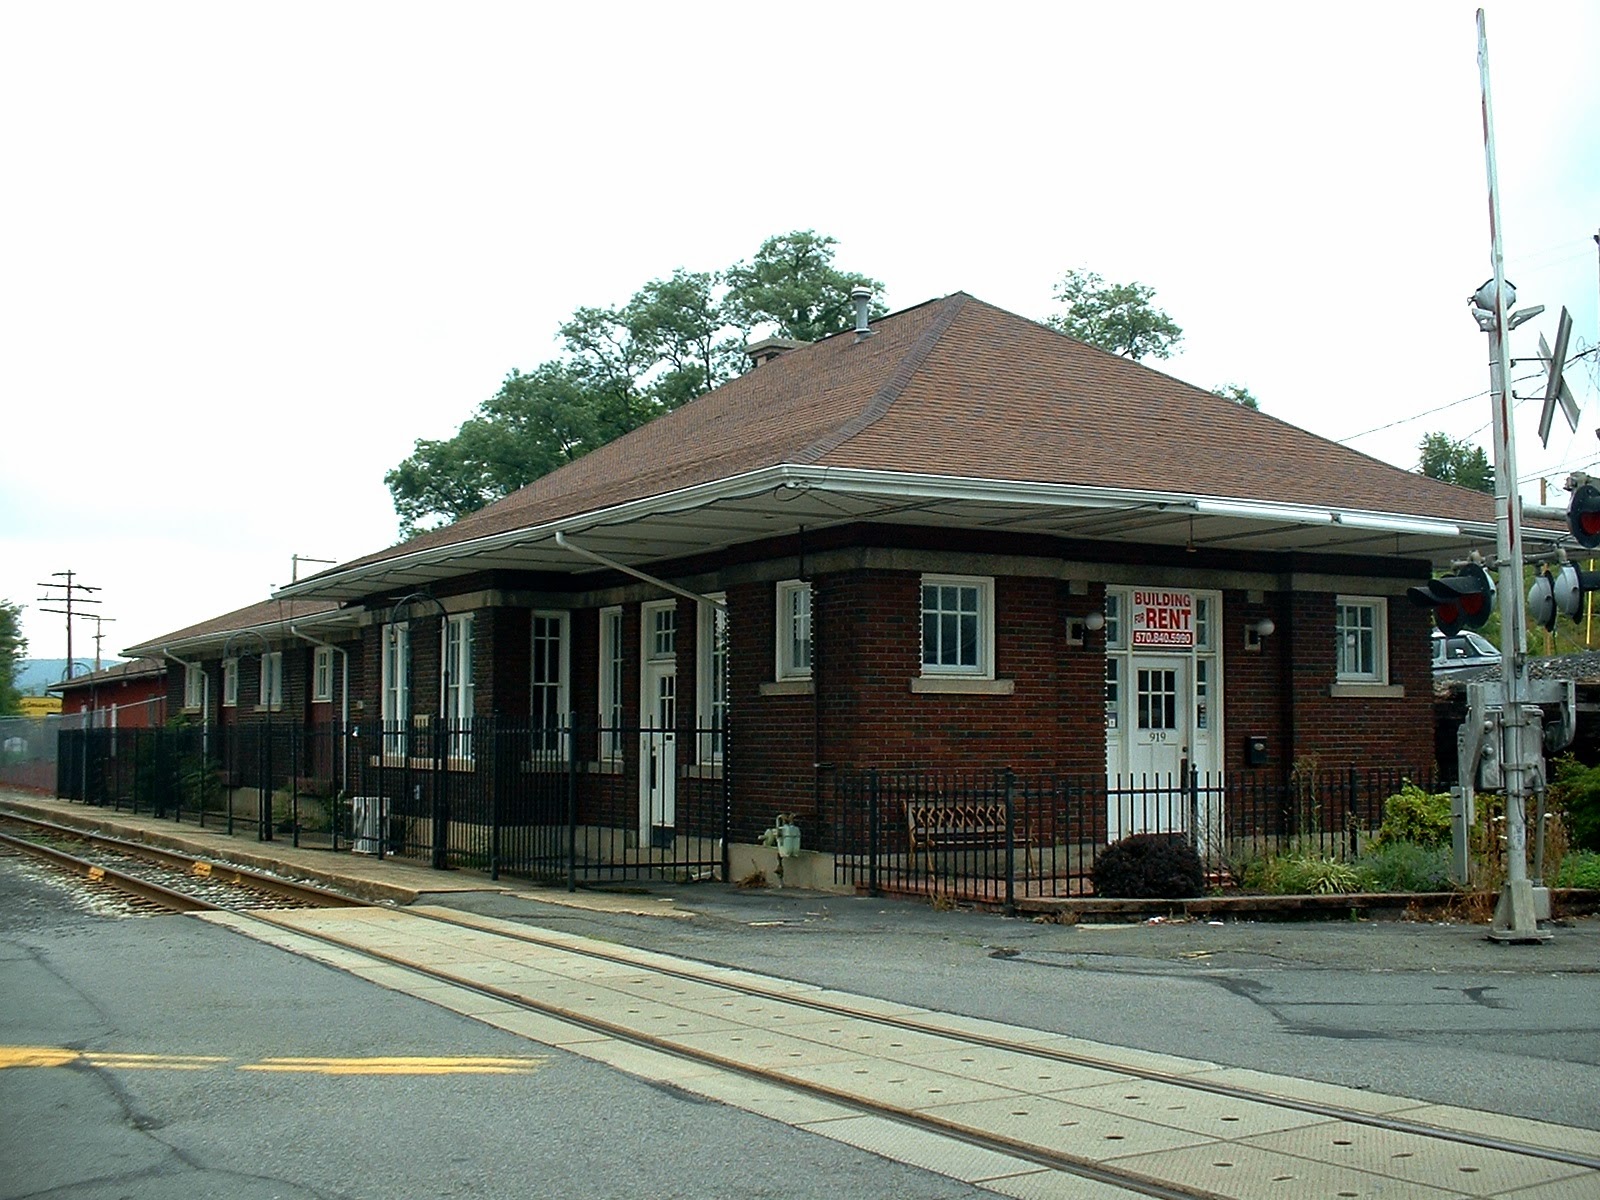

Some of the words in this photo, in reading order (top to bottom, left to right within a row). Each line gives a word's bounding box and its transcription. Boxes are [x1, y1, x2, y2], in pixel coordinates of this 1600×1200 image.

[1134, 591, 1191, 607] BUILDING
[1146, 607, 1191, 629] RENT
[1149, 731, 1167, 742] 919
